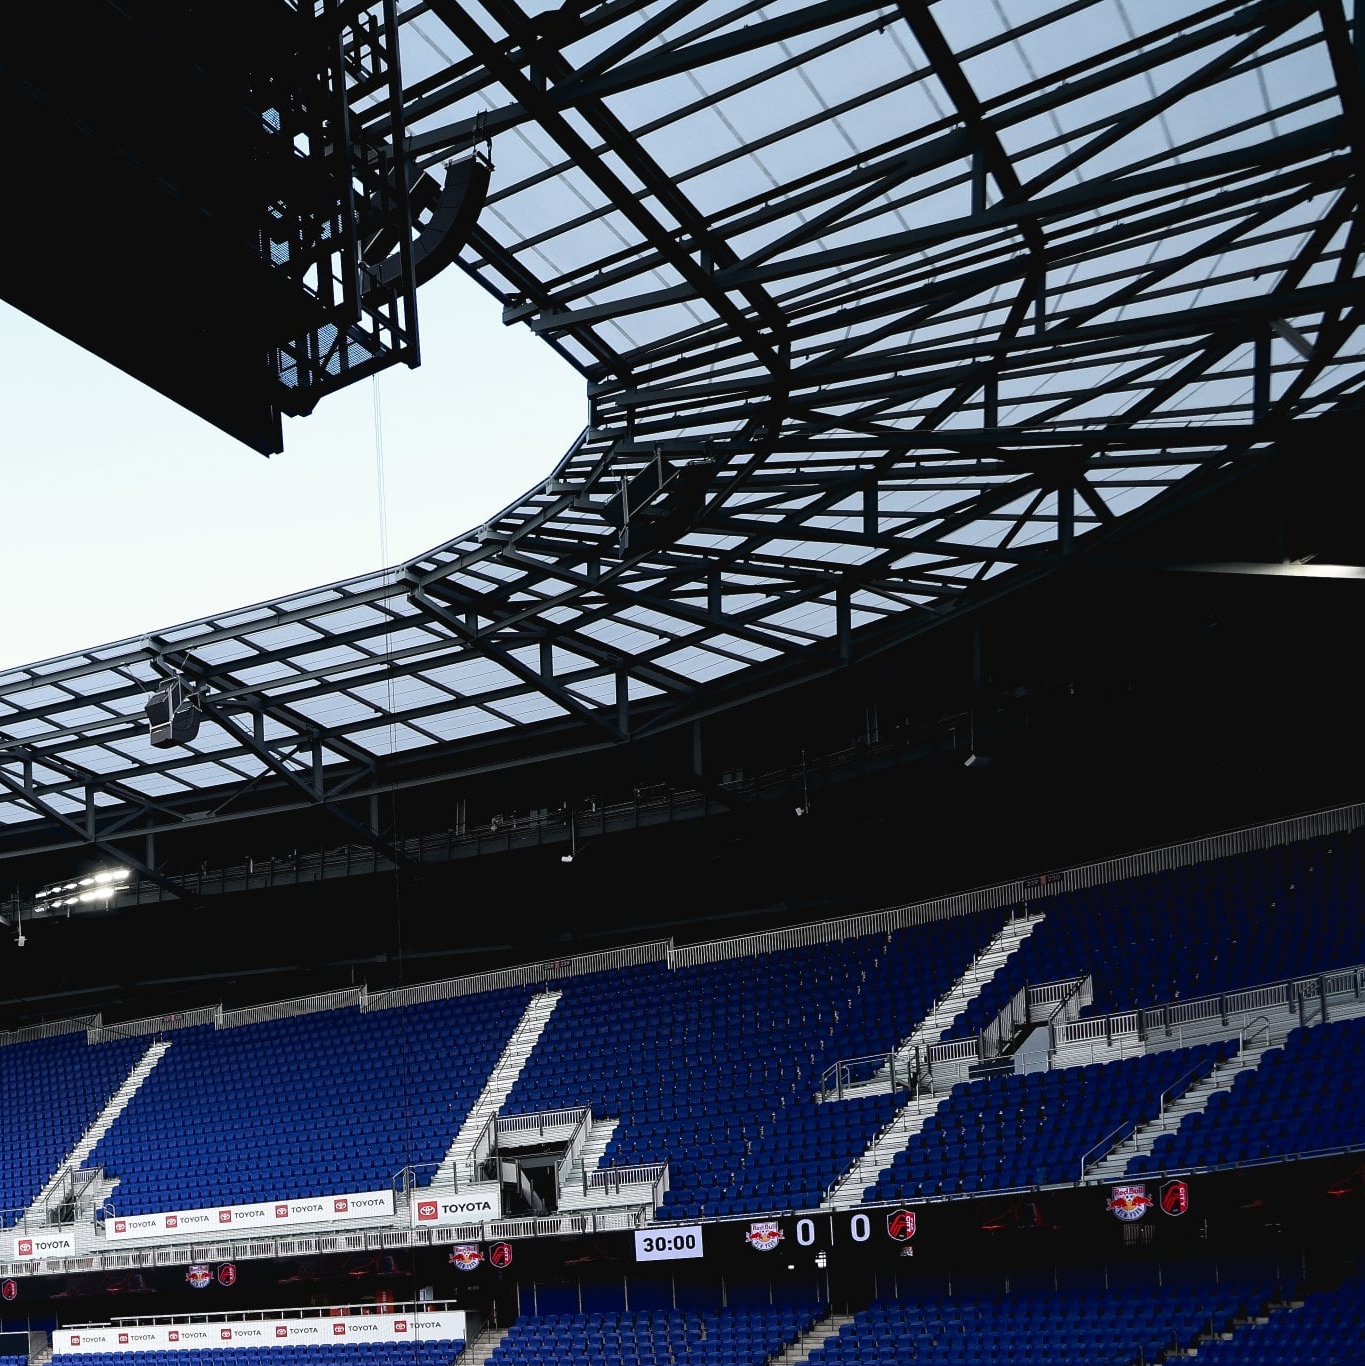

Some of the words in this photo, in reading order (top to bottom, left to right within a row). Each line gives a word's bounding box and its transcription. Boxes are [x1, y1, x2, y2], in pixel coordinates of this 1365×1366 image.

[351, 1198, 385, 1208] TOYOTA
[441, 1202, 491, 1214] TOYOTA
[291, 1204, 323, 1214] TOYOTA
[180, 1215, 209, 1224] TOYOTA
[235, 1210, 265, 1219] TOYOTA
[129, 1220, 157, 1229] TOYOTA
[851, 1214, 871, 1242] 0
[796, 1218, 815, 1246] 0
[35, 1240, 70, 1250] TOYOTA
[643, 1234, 695, 1252] 30:00
